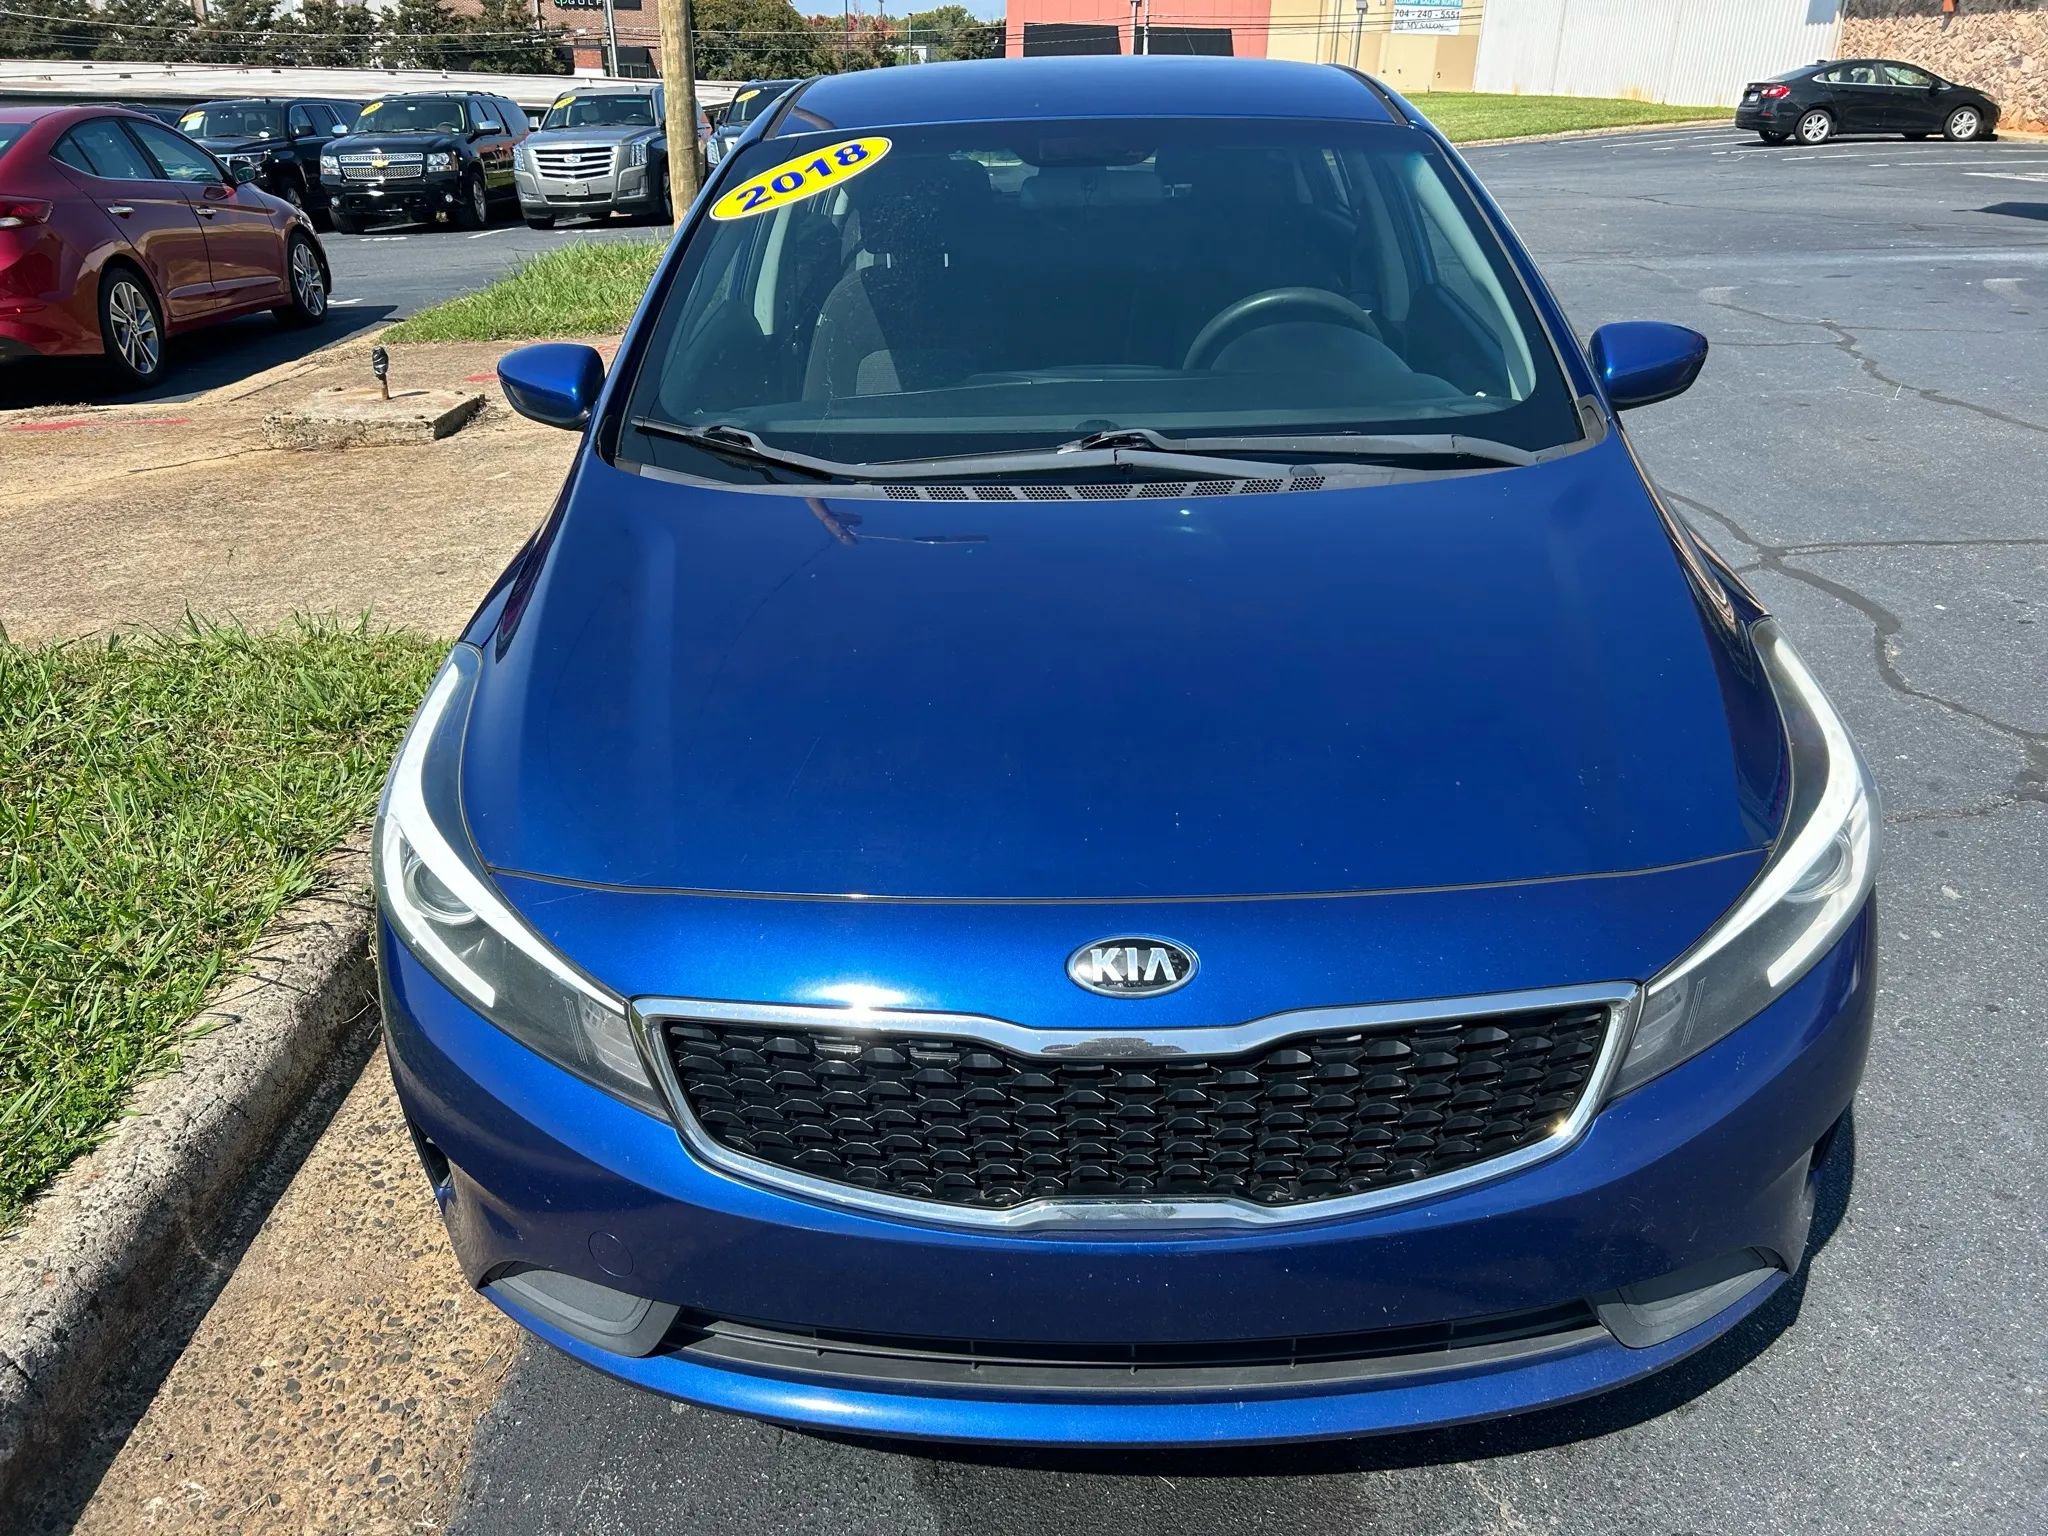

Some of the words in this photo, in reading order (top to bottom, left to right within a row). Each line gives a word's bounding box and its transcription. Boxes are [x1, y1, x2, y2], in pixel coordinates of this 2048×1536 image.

[1395, 9, 1409, 17] 704
[1417, 9, 1433, 18] 240
[1440, 10, 1460, 19] 5551
[736, 143, 869, 212] 2018
[1090, 947, 1177, 982] KIA
